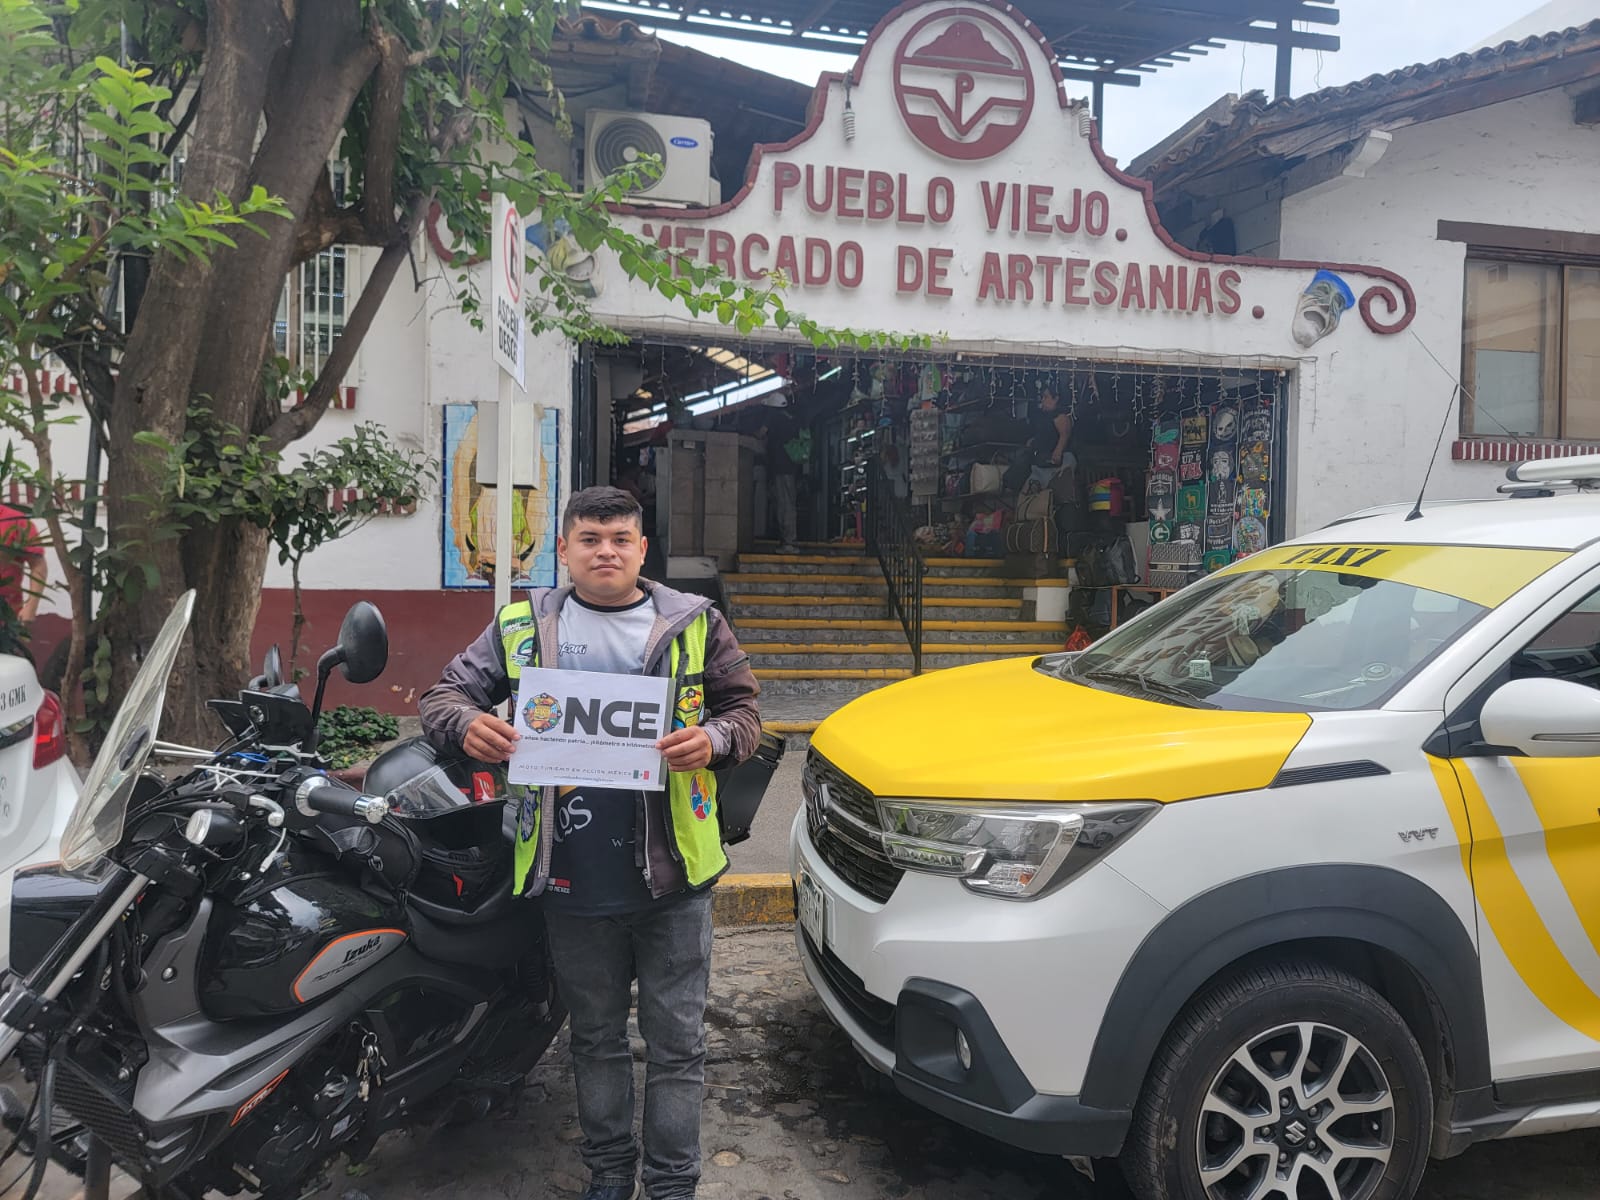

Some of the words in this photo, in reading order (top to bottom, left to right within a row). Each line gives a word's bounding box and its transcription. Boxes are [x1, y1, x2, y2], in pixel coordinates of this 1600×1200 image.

[773, 160, 955, 226] PUEBLO
[642, 223, 865, 290] MERCADO
[897, 245, 954, 297] DE
[1280, 547, 1392, 567] TAXI
[8, 684, 27, 706] GMK
[342, 934, 382, 965] Izuka
